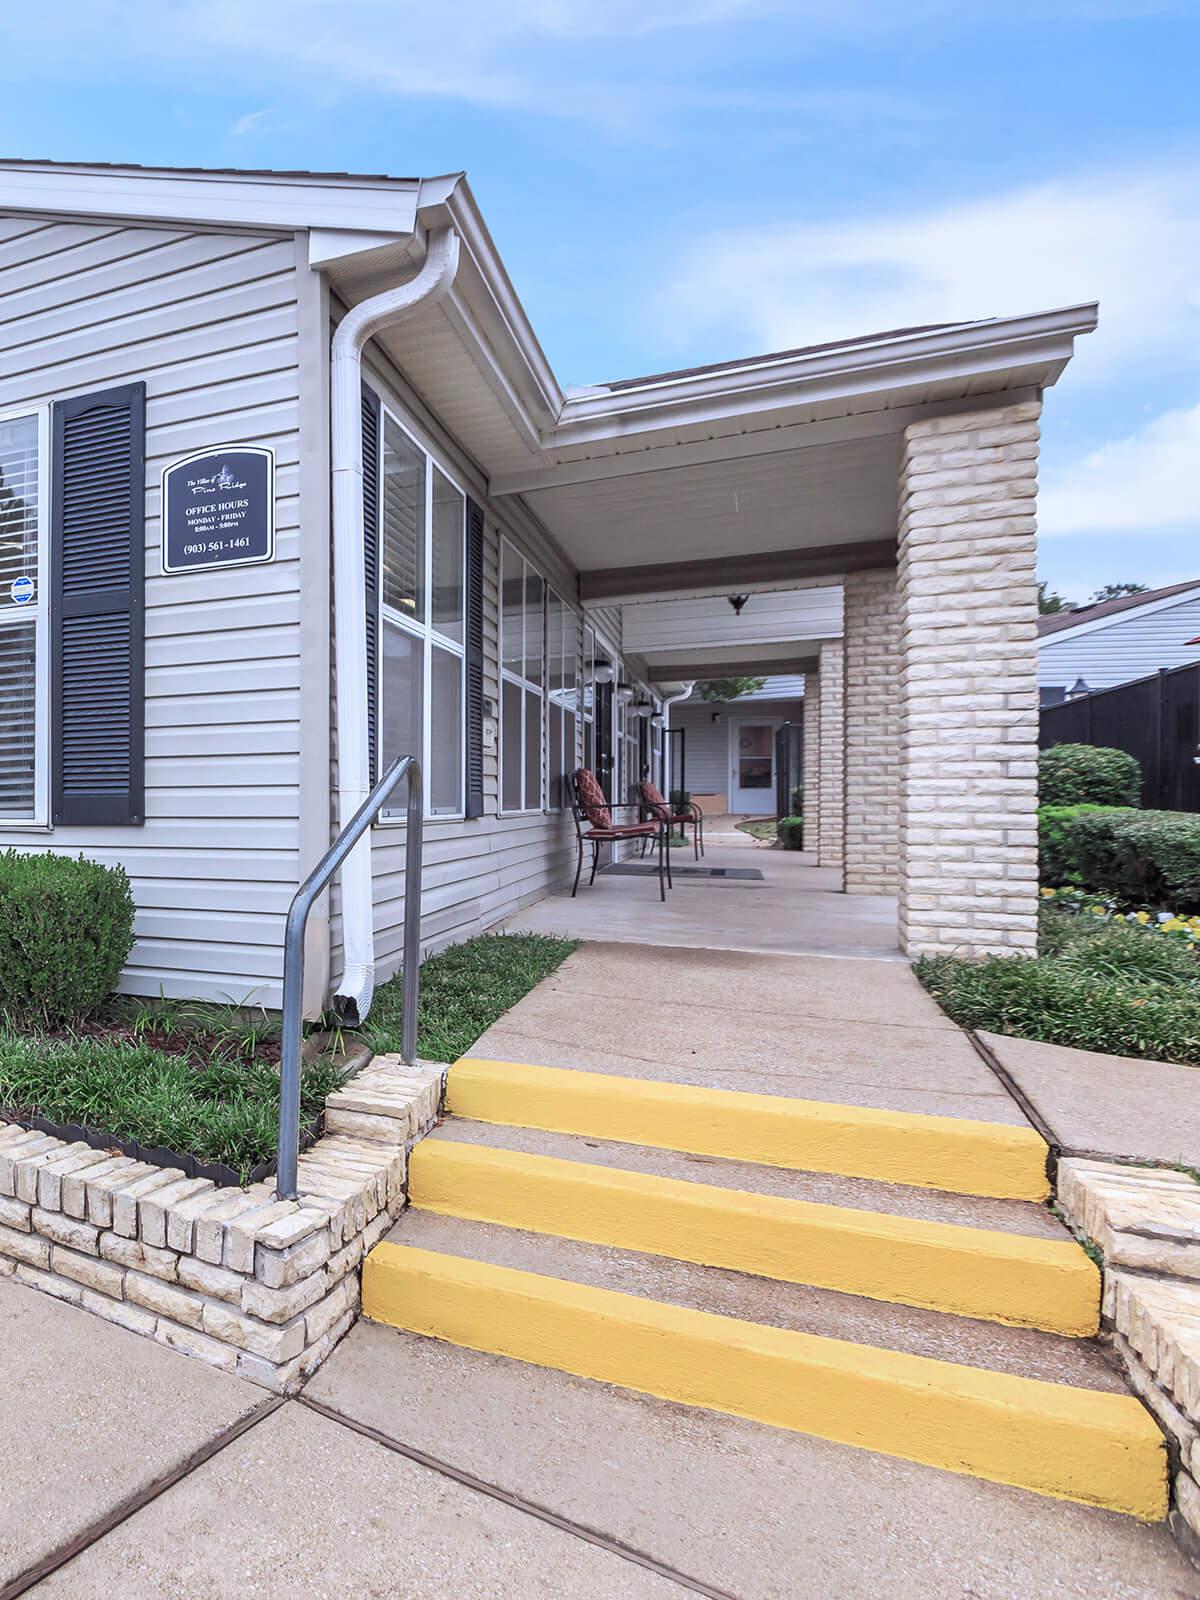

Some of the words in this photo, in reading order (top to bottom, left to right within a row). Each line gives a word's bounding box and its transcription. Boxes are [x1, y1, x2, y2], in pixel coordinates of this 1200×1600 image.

[192, 486, 216, 495] Pine
[219, 481, 247, 490] Ridge
[185, 504, 217, 516] OFFICE
[218, 499, 249, 511] HOURS
[187, 515, 217, 526] MONDAY
[221, 511, 247, 521] FRIDAY
[184, 543, 206, 555] (903)
[208, 537, 250, 551] 561-1461
